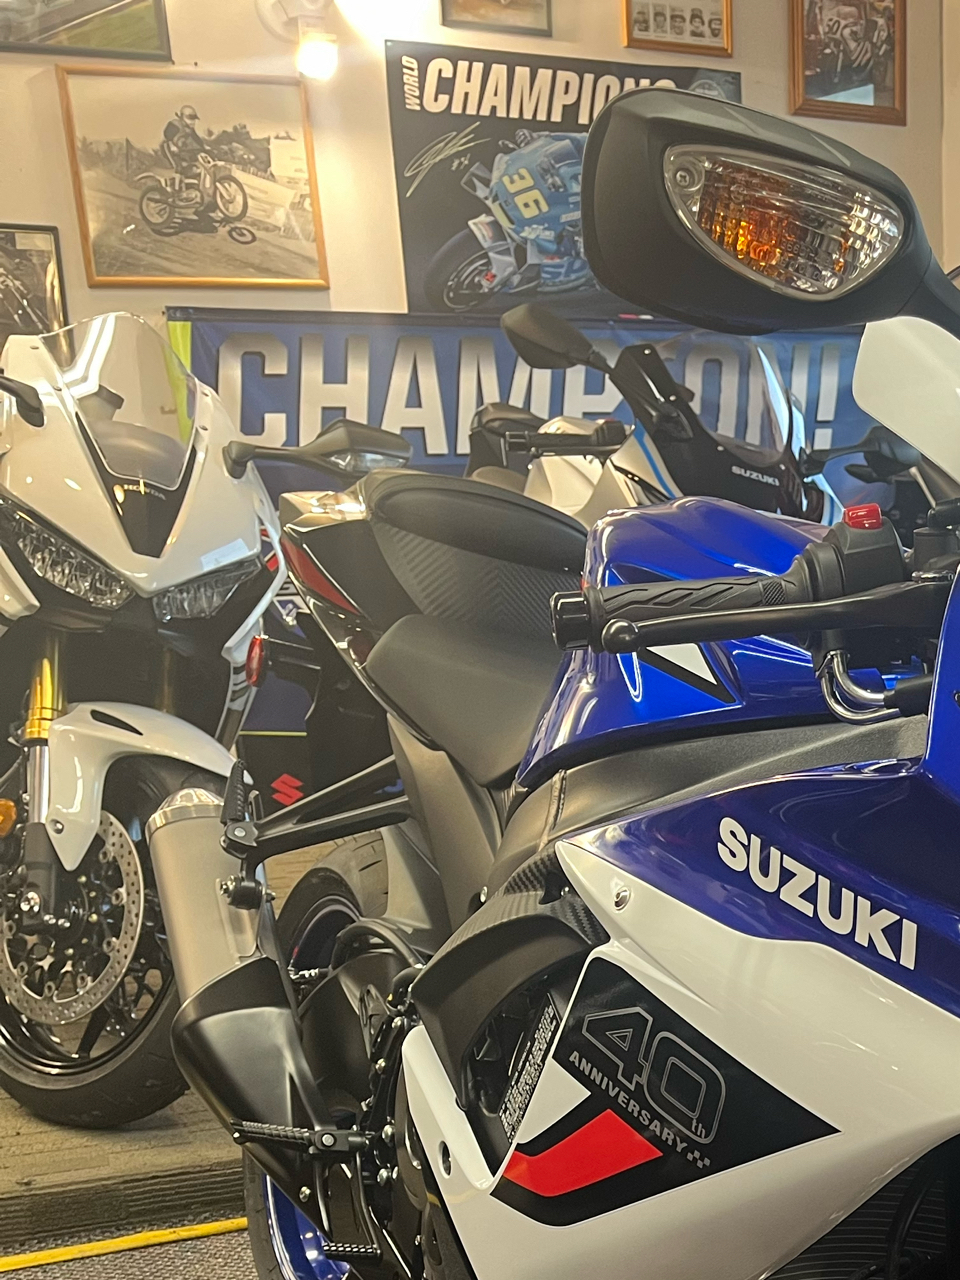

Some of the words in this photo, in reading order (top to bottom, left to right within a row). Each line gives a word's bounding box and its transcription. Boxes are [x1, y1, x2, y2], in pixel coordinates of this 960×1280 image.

[401, 55, 421, 111] WORLD
[422, 57, 677, 125] CHAMPIO
[502, 167, 549, 219] 36
[217, 331, 840, 455] CHAMPON!
[731, 464, 780, 486] SUZUKI
[717, 816, 918, 971] SUZUKI
[568, 1050, 688, 1153] ANNIVERSARY
[582, 1006, 727, 1145] 40
[691, 1117, 706, 1139] th
